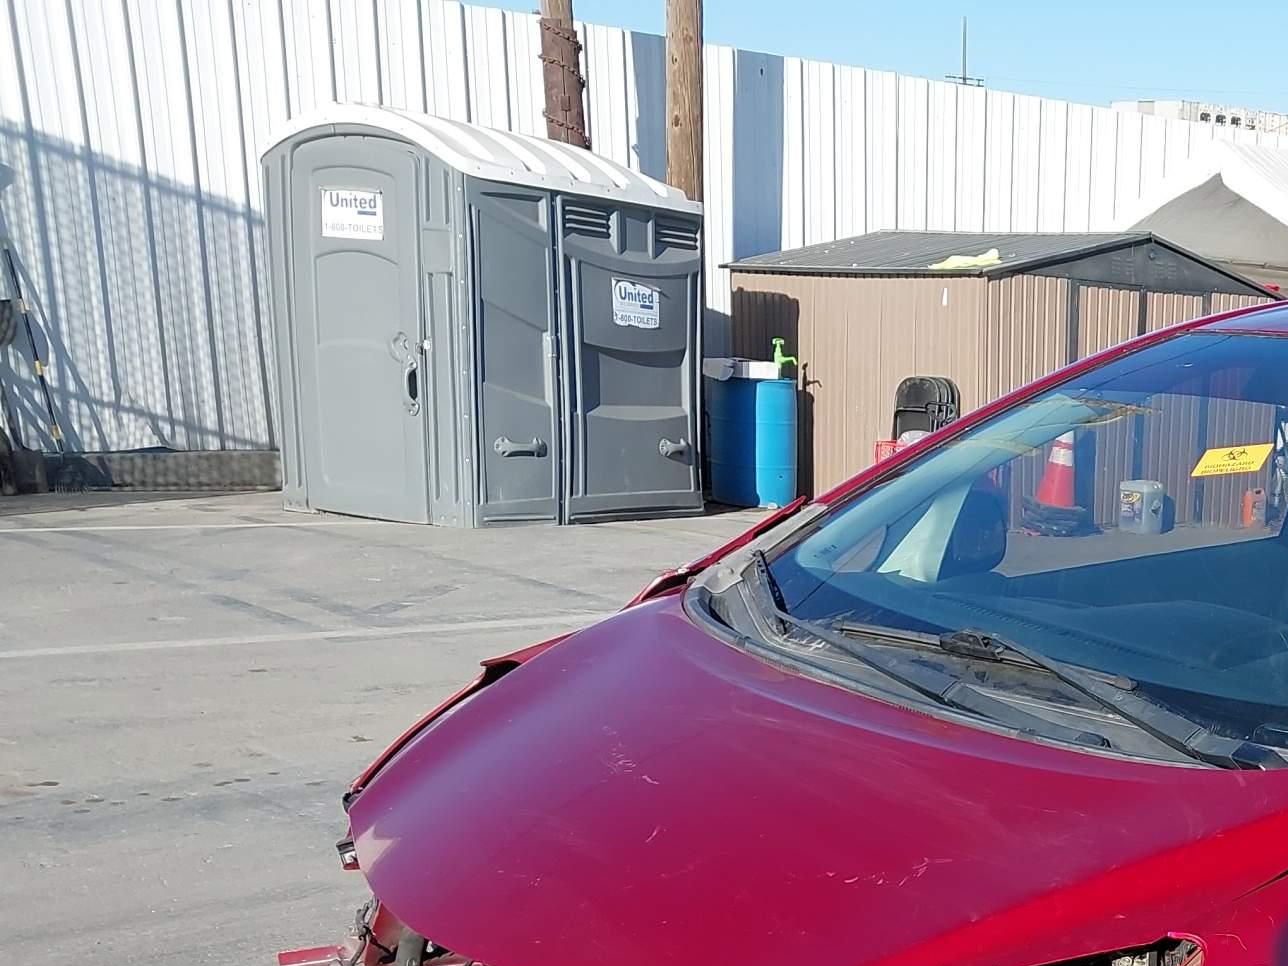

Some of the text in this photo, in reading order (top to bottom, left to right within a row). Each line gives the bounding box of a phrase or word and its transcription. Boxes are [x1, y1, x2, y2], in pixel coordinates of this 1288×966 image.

[329, 191, 377, 209] United
[324, 223, 384, 234] 1-800-TOILETS
[618, 285, 654, 304] United
